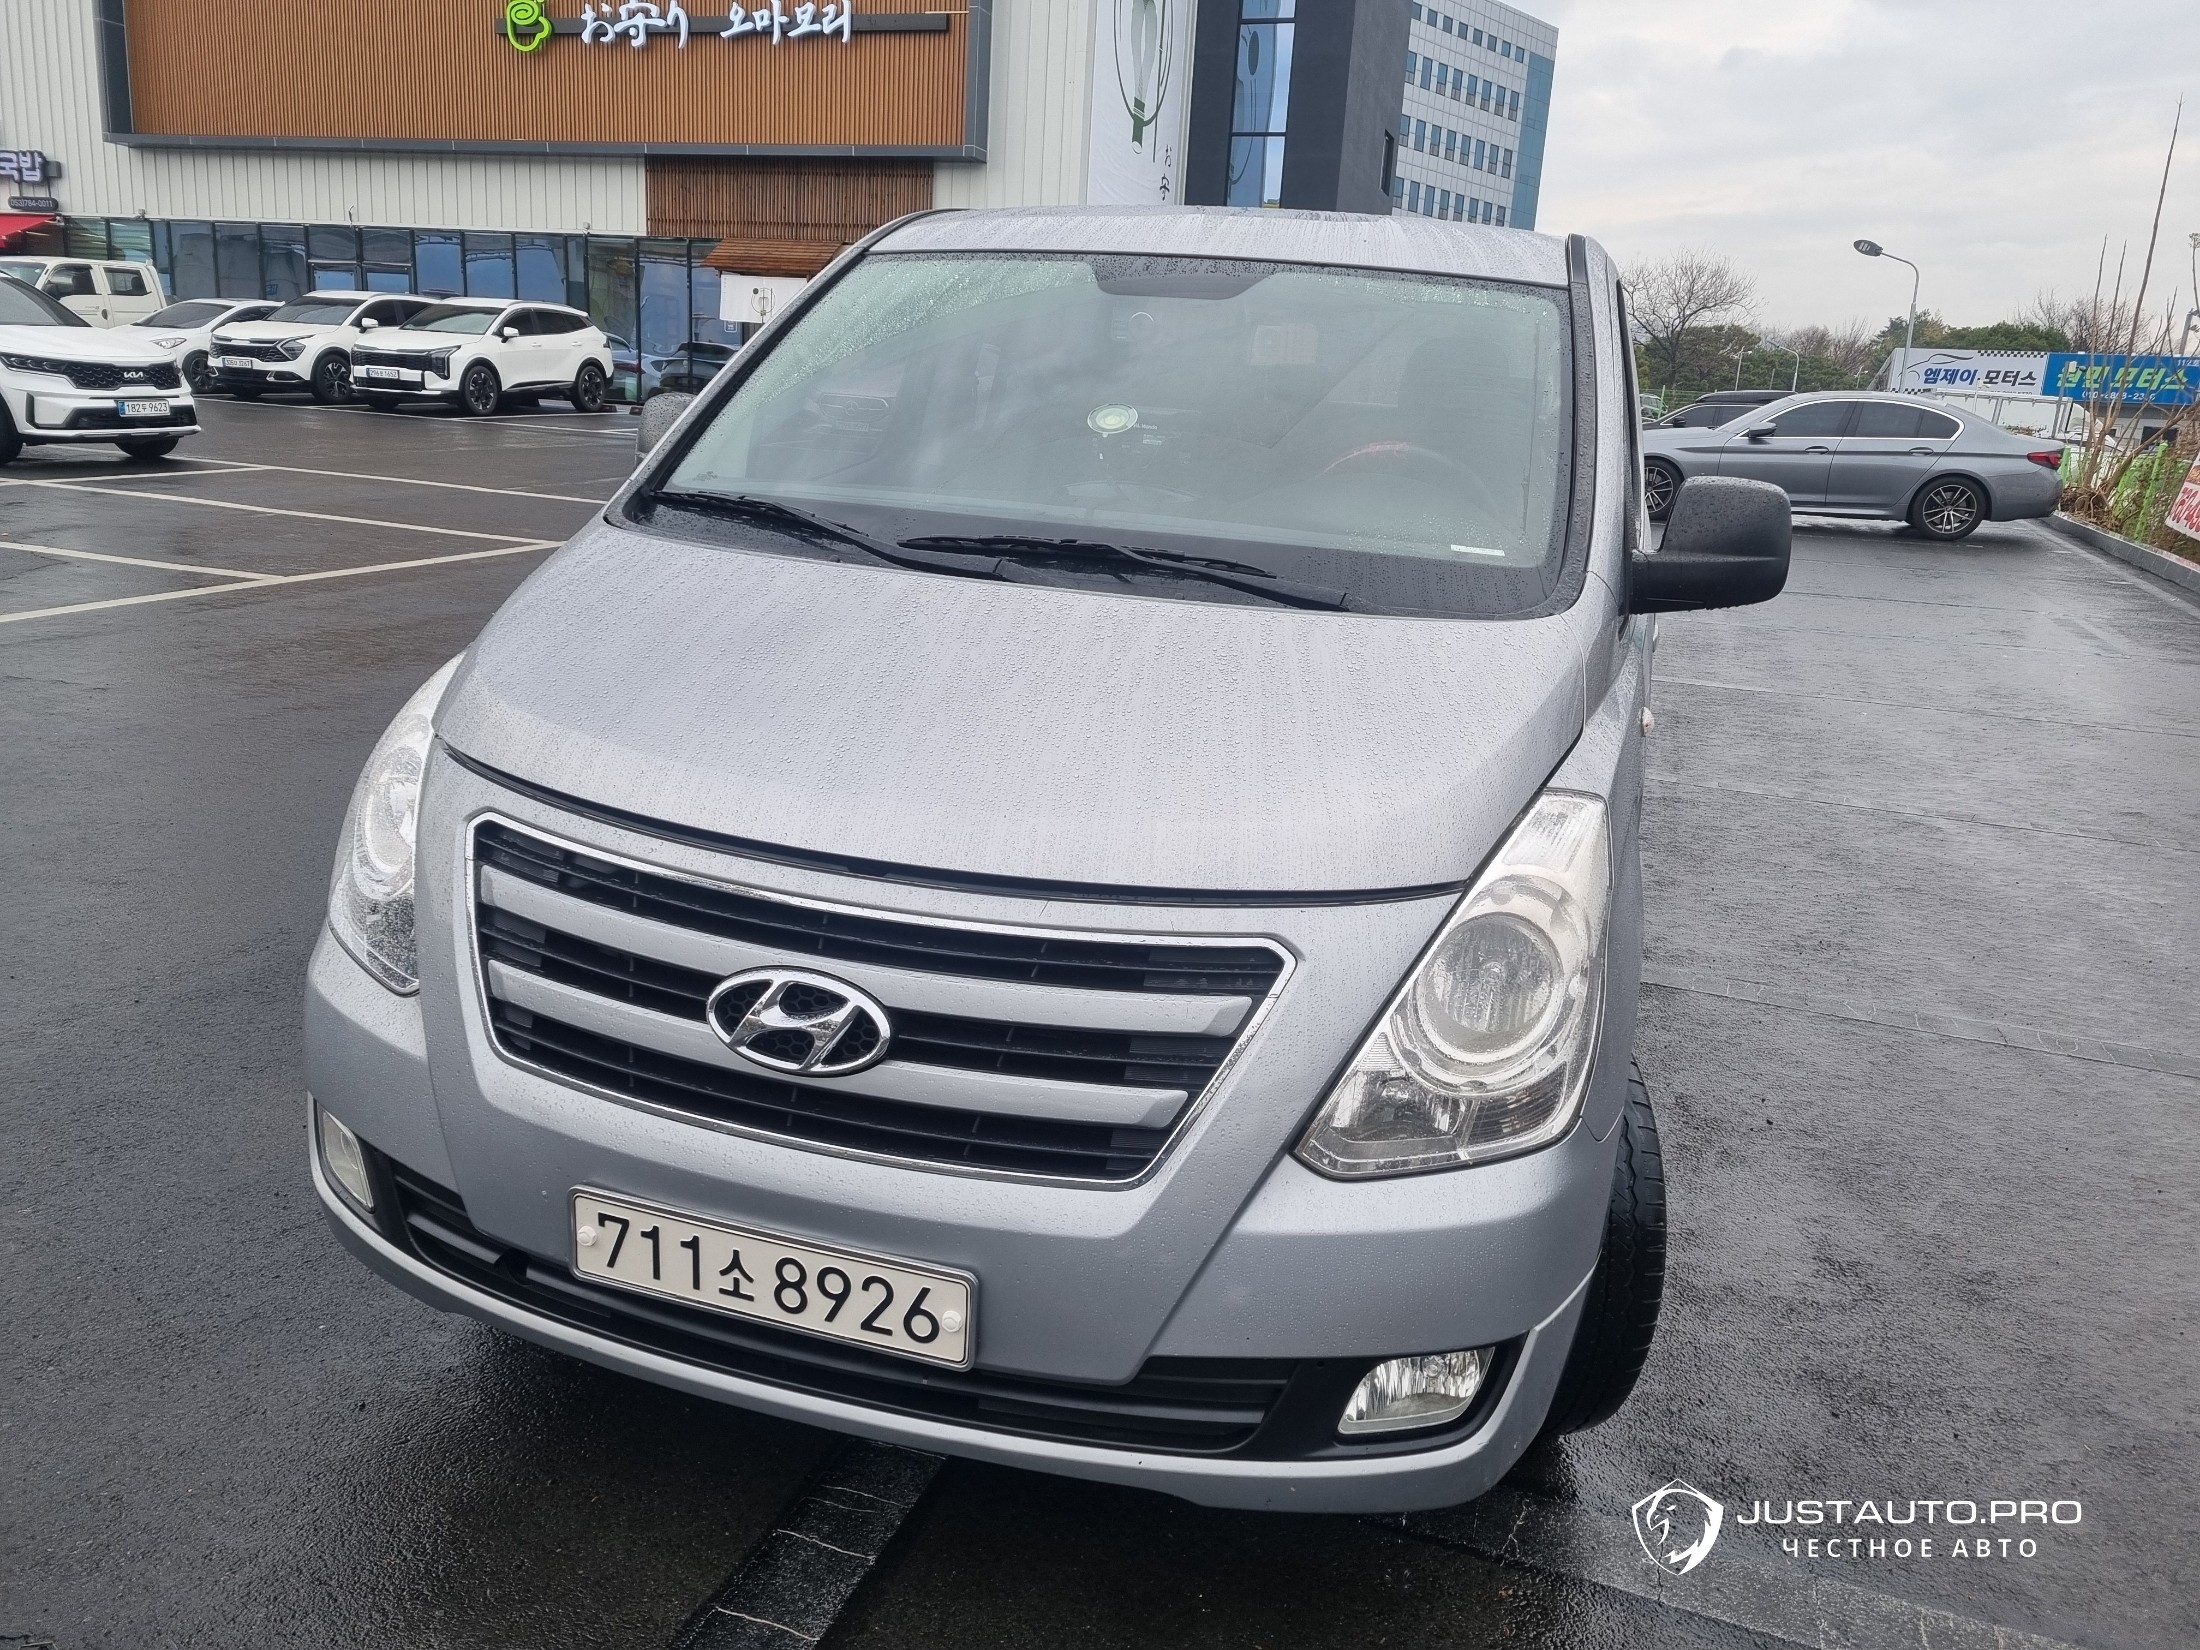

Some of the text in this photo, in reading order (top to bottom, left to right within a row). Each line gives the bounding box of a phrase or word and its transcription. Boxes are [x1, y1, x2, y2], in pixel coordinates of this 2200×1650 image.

[581, 0, 689, 49] お守り
[123, 371, 144, 379] KIA
[1923, 367, 2038, 387] 엠제이 모터스
[148, 402, 168, 412] 9623
[597, 1211, 940, 1344] 711소8926
